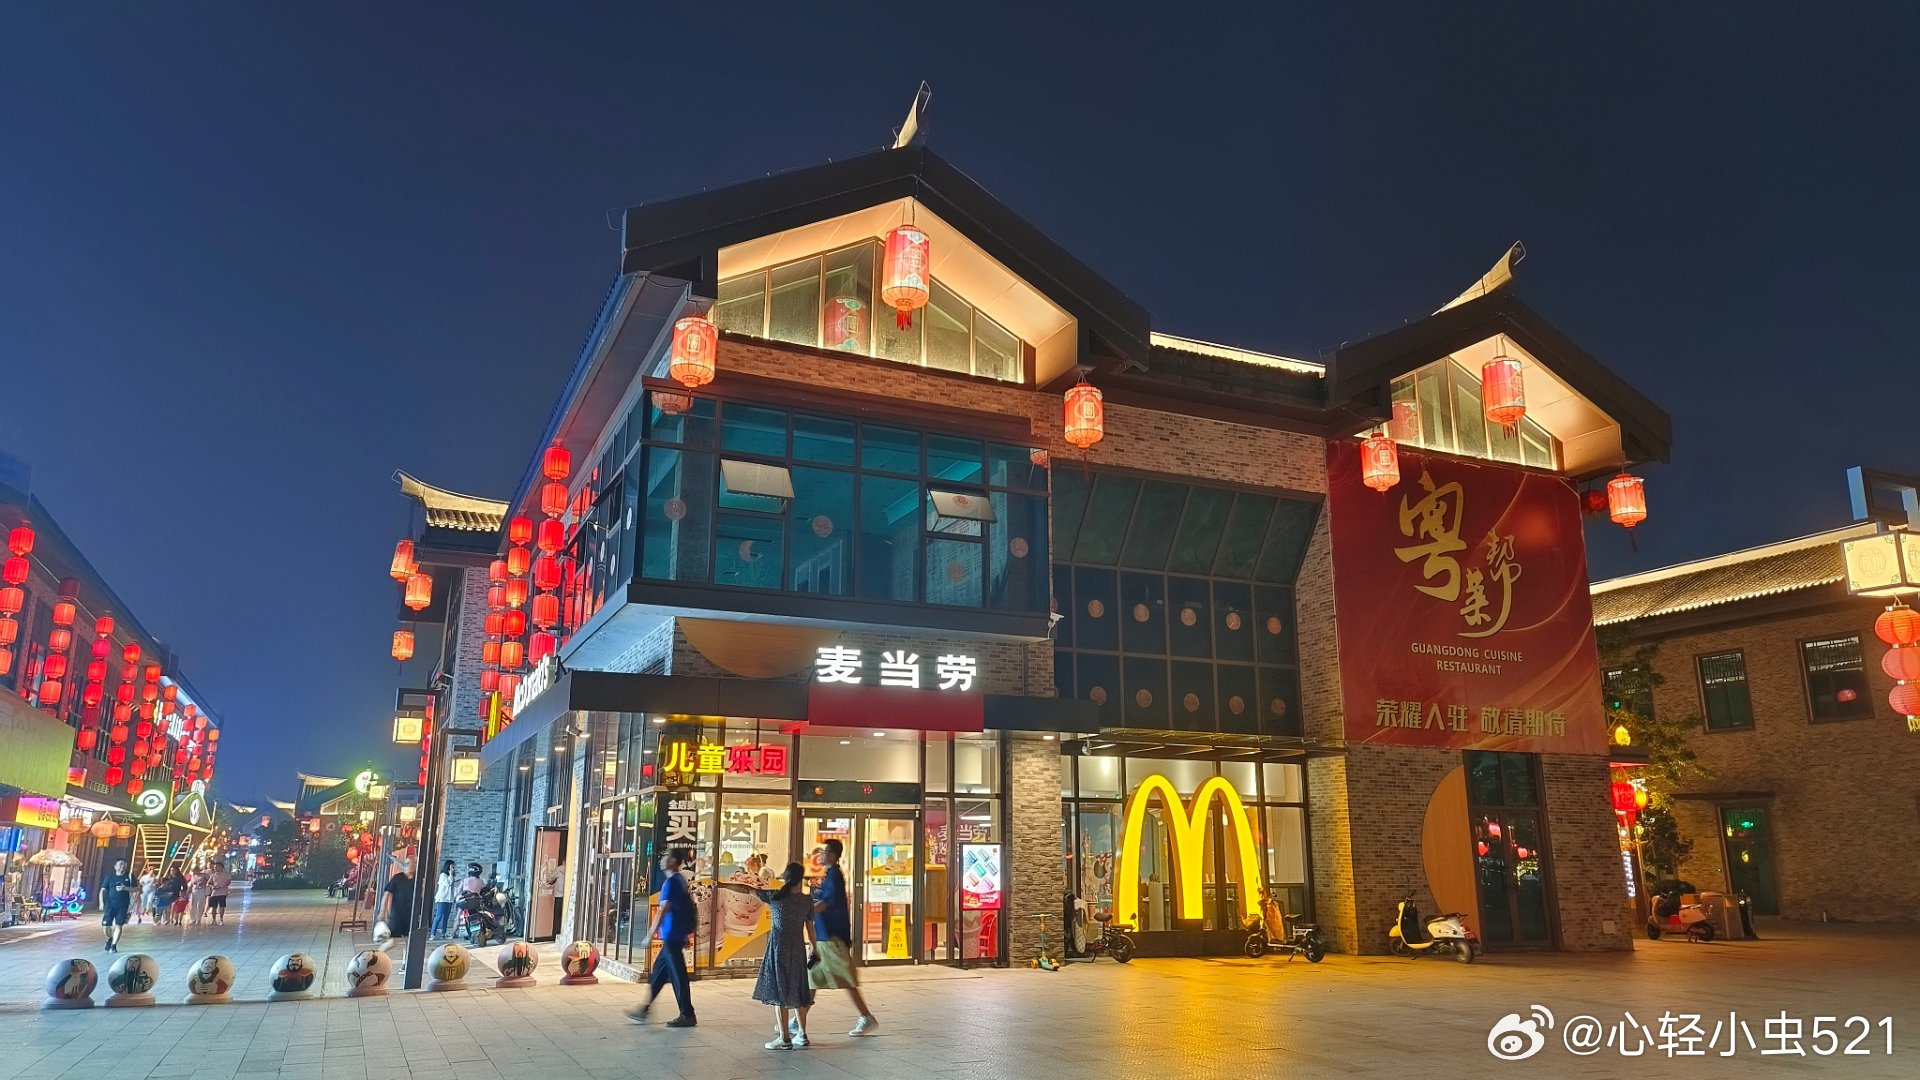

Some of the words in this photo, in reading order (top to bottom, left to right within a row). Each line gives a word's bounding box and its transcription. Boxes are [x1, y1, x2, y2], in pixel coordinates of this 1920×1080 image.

[815, 645, 977, 692] 麦当劳
[1411, 642, 1479, 659] GUANGDONG
[1484, 650, 1523, 662] CUISINE
[1436, 660, 1502, 675] RESTAURANT
[1376, 699, 1469, 733] 荣耀入驻
[1480, 705, 1567, 738] 敬请期待
[664, 741, 788, 776] 儿童乐园
